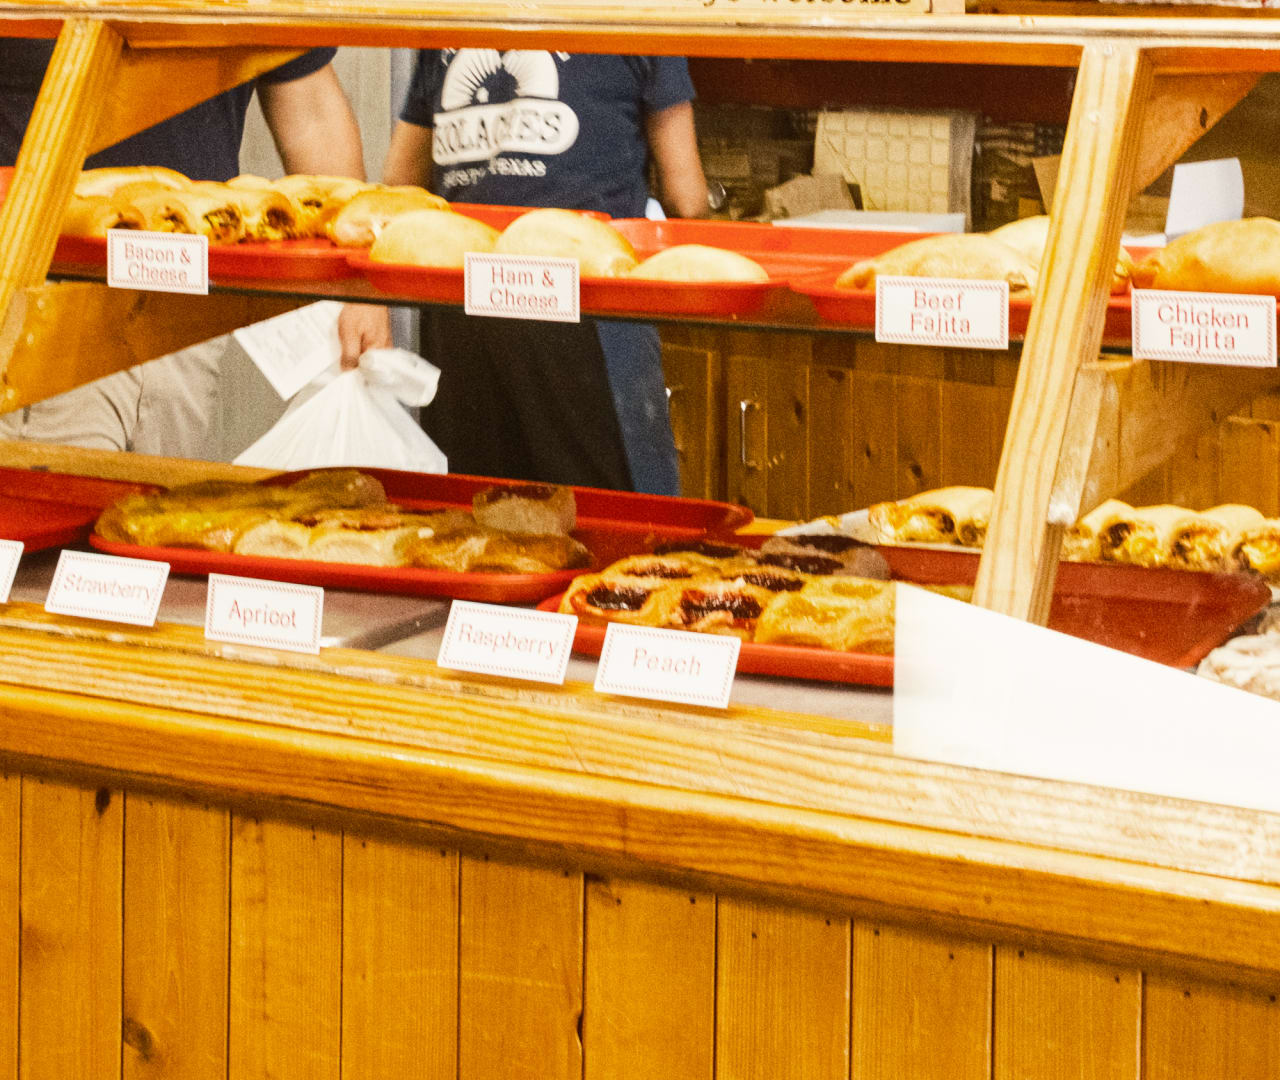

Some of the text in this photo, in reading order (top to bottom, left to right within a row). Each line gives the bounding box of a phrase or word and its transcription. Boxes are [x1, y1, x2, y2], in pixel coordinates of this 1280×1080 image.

[124, 241, 192, 265] Bacon &
[128, 261, 188, 282] Cheese
[490, 265, 556, 288] Ham &
[489, 287, 559, 310] Cheese
[913, 288, 966, 311] Beef
[910, 311, 971, 338] Fajita
[1157, 302, 1250, 330] Chicken
[1169, 326, 1236, 354] Fajita
[62, 571, 153, 607] Strawberry
[228, 599, 297, 630] Apricot
[457, 622, 560, 660] Raspberry
[631, 646, 703, 677] Peach
